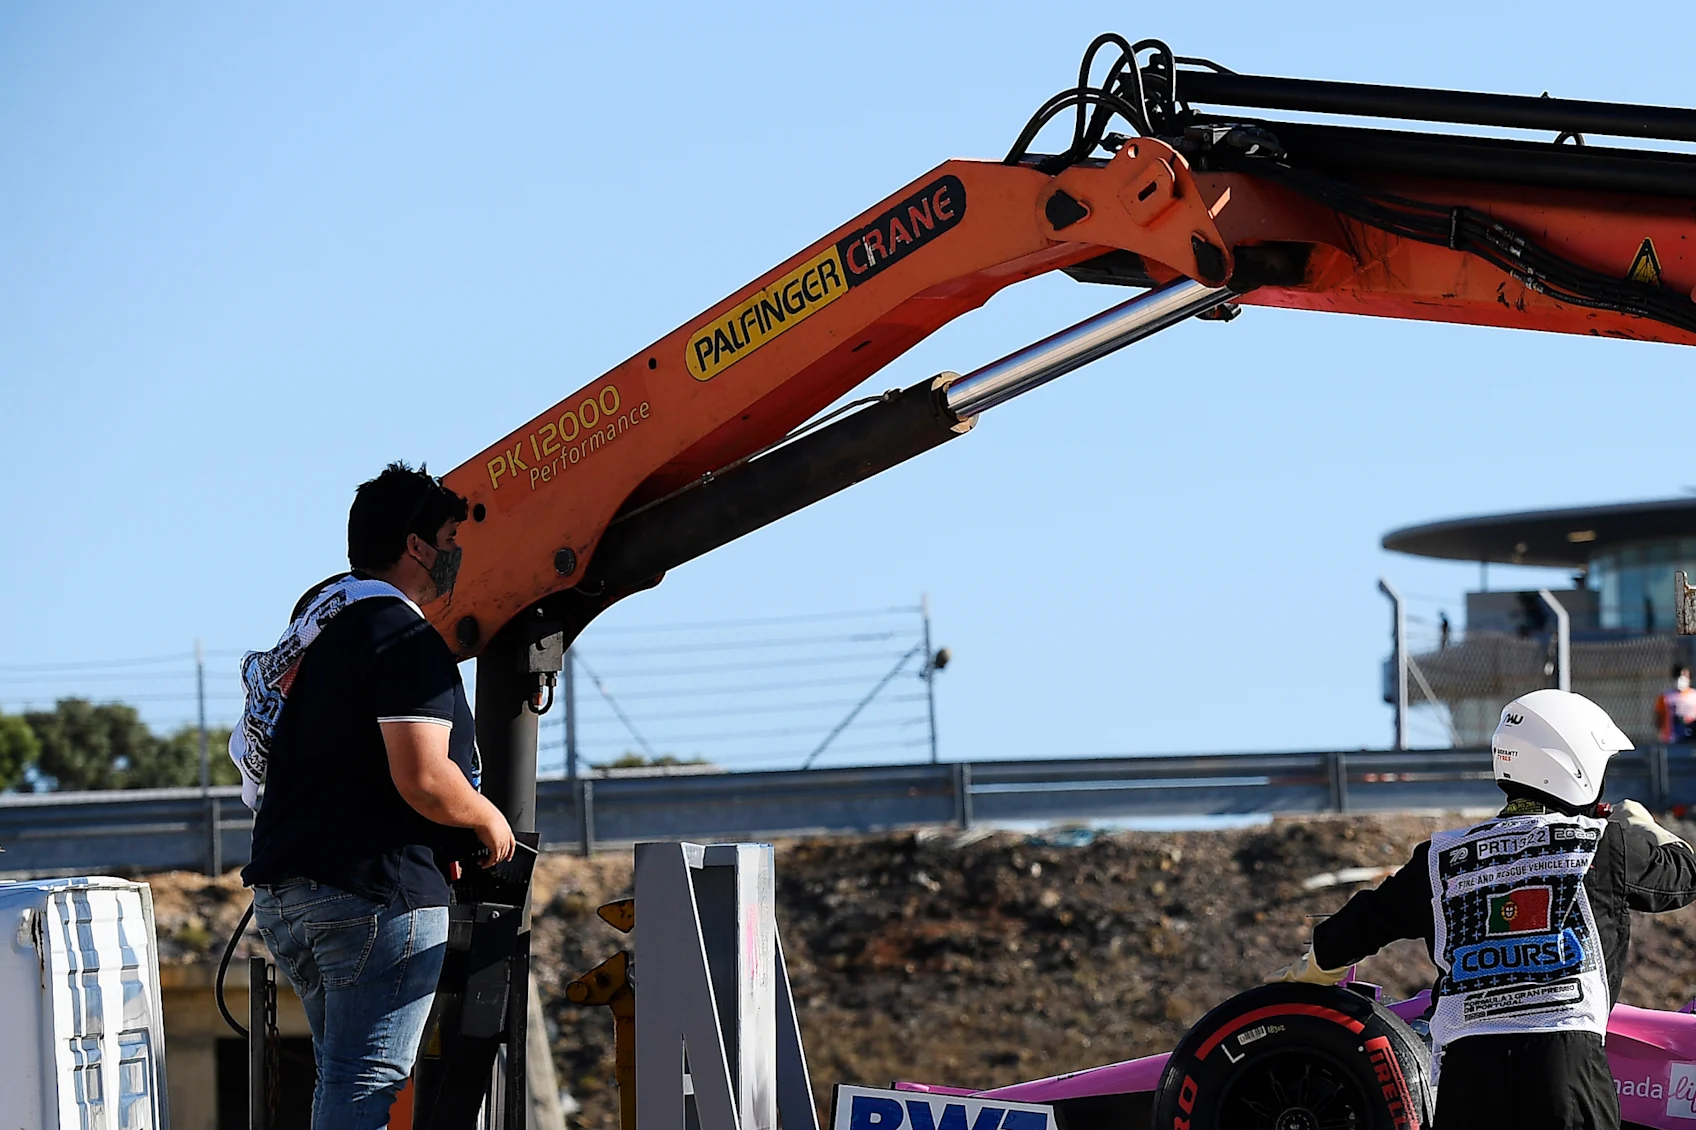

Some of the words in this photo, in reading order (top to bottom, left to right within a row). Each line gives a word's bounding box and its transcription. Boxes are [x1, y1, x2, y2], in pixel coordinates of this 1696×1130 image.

[694, 258, 842, 372] PALFINGER
[846, 186, 954, 274] CRANE
[487, 442, 528, 490] PK
[530, 385, 620, 462] 12000
[530, 401, 650, 490] Performance
[1458, 877, 1476, 889] FIRE
[1477, 874, 1494, 885] AND
[1528, 859, 1563, 872] VEHICLE
[1565, 858, 1589, 869] TEAM
[1478, 830, 1546, 857] PRT1322
[1462, 939, 1576, 972] COURSE
